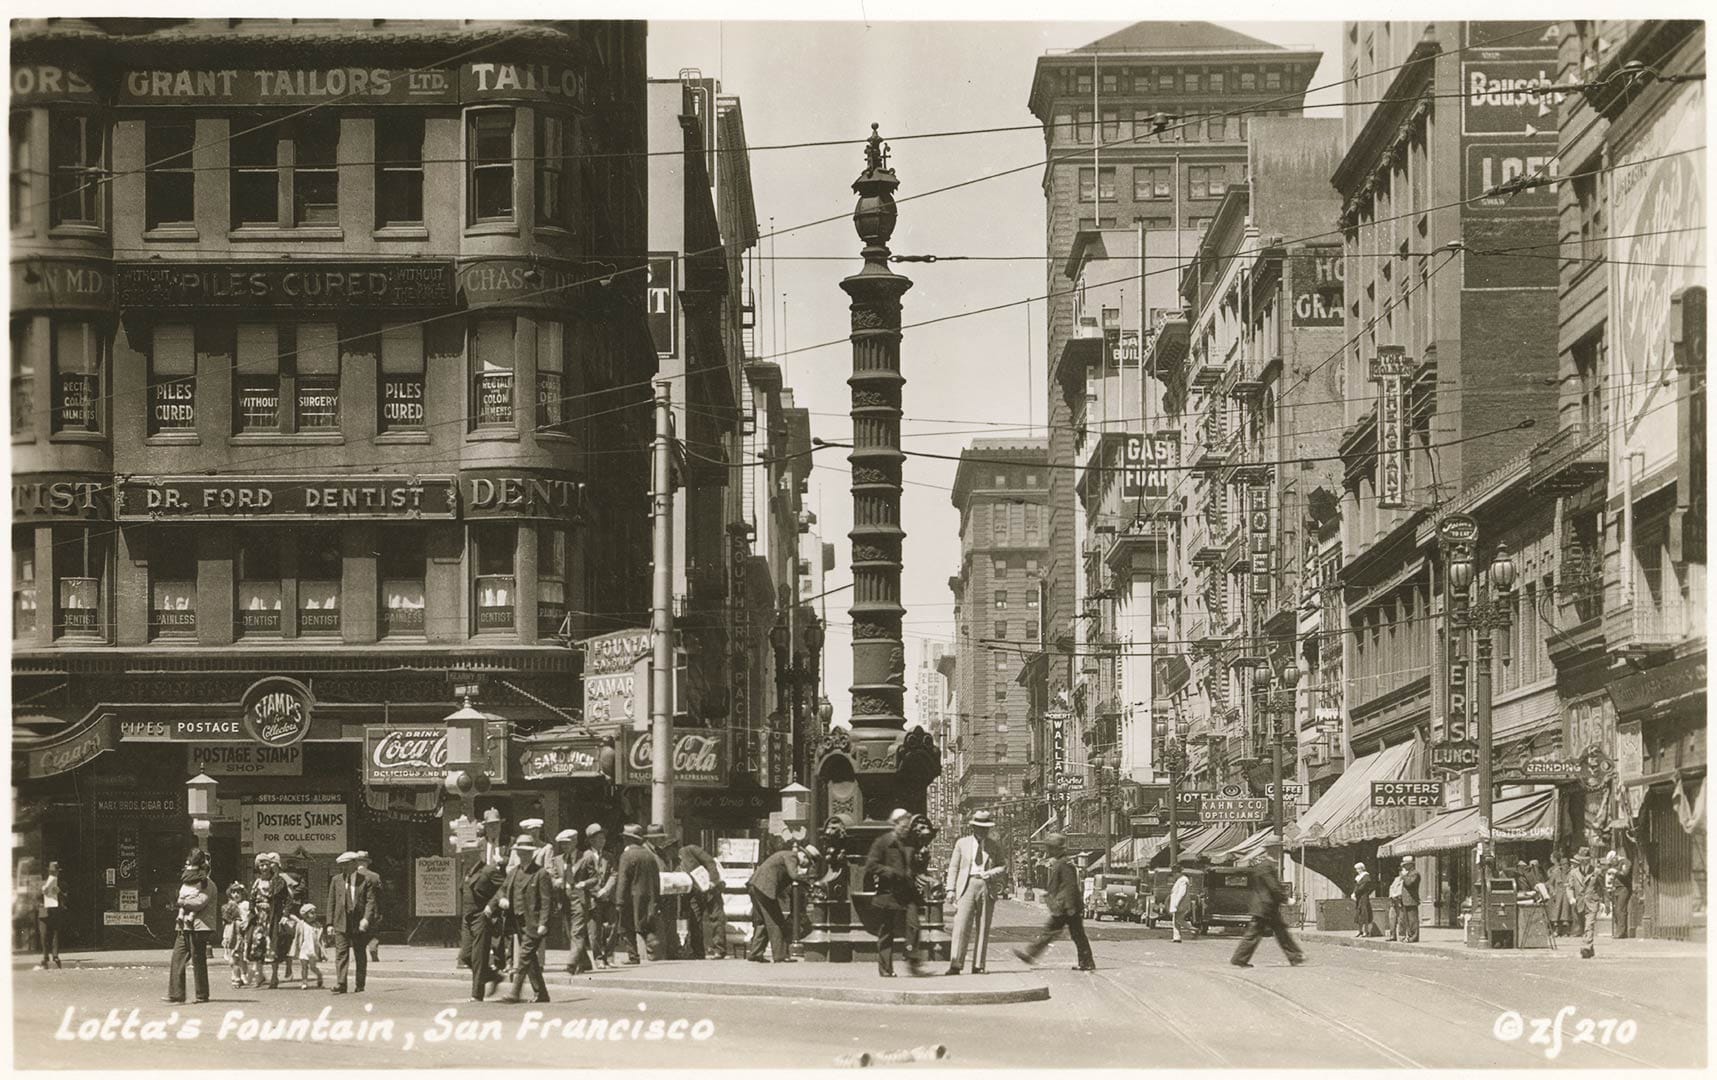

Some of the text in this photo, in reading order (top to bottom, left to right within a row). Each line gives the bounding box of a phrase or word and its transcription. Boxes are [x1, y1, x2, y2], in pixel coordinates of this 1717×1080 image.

[128, 69, 448, 96] GRANT TAILORS LTD.
[1470, 70, 1553, 106] Bausch
[182, 272, 268, 297] PILES
[1112, 348, 1140, 360] BUIL
[156, 385, 192, 400] PILES
[385, 383, 422, 399] PILES
[240, 397, 278, 408] WITHOUT
[299, 396, 338, 407] SURGERY
[483, 394, 508, 404] COLON
[155, 404, 193, 421] CURED
[384, 402, 423, 420] CURED
[1385, 378, 1398, 502] PHEASANT
[1127, 438, 1168, 461] GAS
[147, 487, 424, 508] DR. FORD DENTIST
[1253, 489, 1268, 593] HOTEL
[64, 615, 95, 625] DENTIST
[156, 614, 195, 625] PAINLESS
[243, 615, 278, 626] DENTIST
[302, 615, 338, 625] DENTIST
[384, 612, 423, 624] PAINLESS
[479, 612, 512, 624] DENTIST
[734, 536, 744, 772] SOUTHERN PACIFIC
[255, 692, 302, 724] STAMPS
[120, 722, 239, 735] PIPES POSTAGE
[261, 721, 298, 741] Collectors
[193, 745, 299, 763] POSTAGE STAMP
[534, 751, 594, 768] SANDWICH
[774, 719, 782, 788] TOWNSE
[226, 764, 265, 772] SHOP
[551, 763, 574, 772] SHOP
[1526, 762, 1582, 773] GRINDING
[1375, 783, 1440, 793] FOSTERS
[140, 800, 162, 810] CIGAR
[163, 800, 175, 810] CO.
[1202, 801, 1233, 810] KAHN
[1249, 800, 1265, 810] CO.
[1375, 796, 1439, 805] BAKERY
[256, 811, 301, 829] POSTAGE
[304, 810, 344, 830] STAMPS
[1205, 811, 1261, 819] OPTICIANS
[263, 833, 337, 841] FOR COLLECTORS
